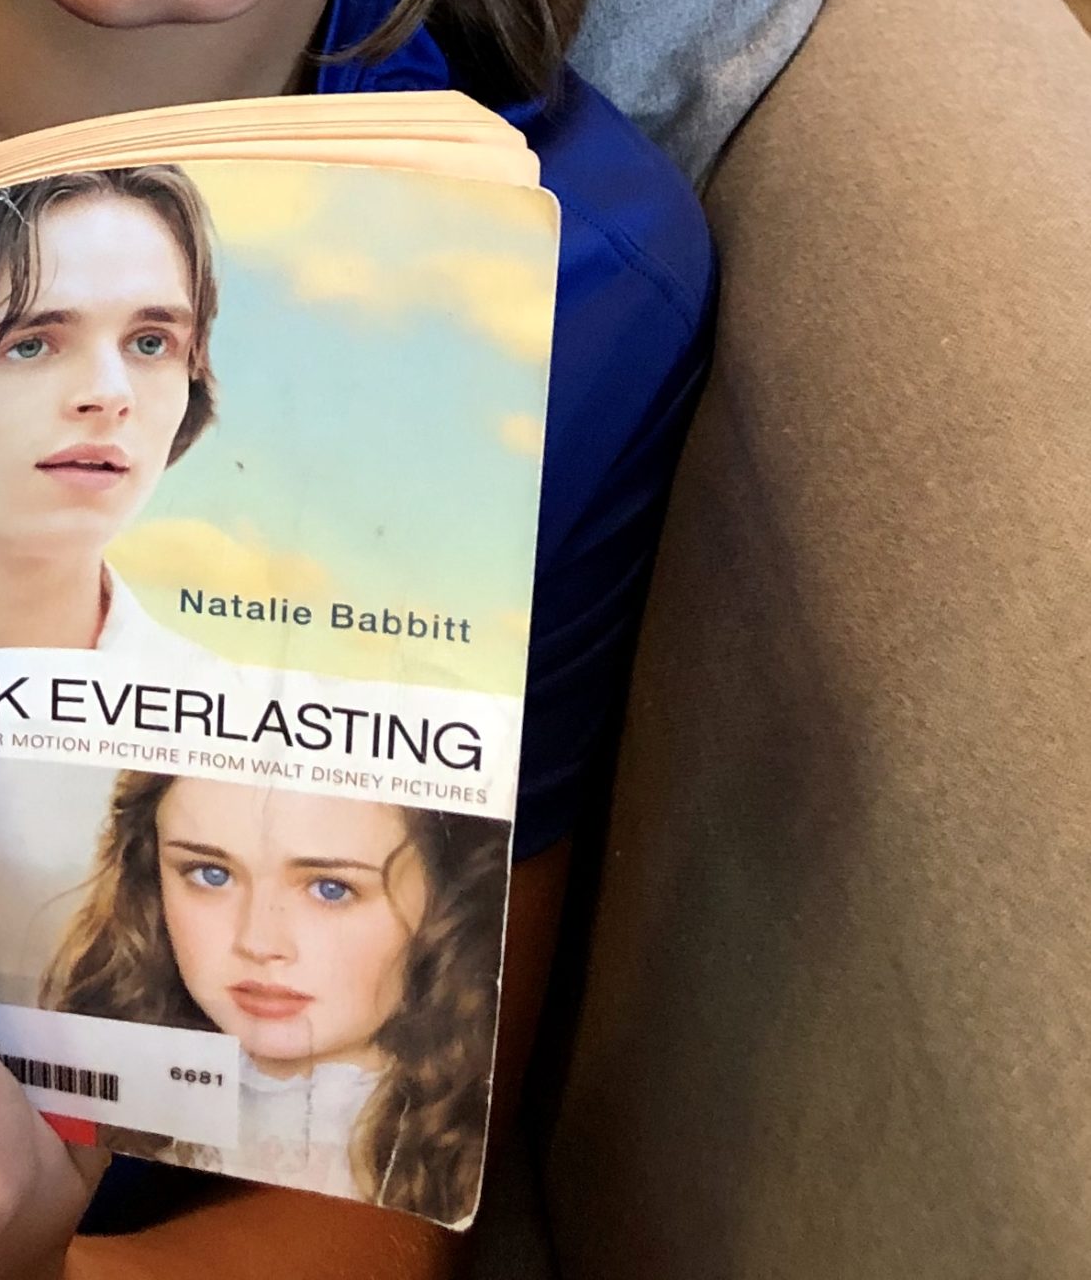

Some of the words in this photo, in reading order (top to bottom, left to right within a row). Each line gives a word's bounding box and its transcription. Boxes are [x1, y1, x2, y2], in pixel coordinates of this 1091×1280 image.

[179, 589, 312, 626] Natalie
[331, 604, 472, 644] Babbitt
[50, 678, 483, 772] EVERLASTING
[12, 734, 91, 753] MOTION
[99, 741, 180, 763] PICTURE
[188, 749, 245, 770] FROM
[251, 759, 304, 779] WALT
[311, 766, 383, 790] DISNEY
[391, 777, 488, 804] PICTURES
[170, 1067, 224, 1086] 6681
